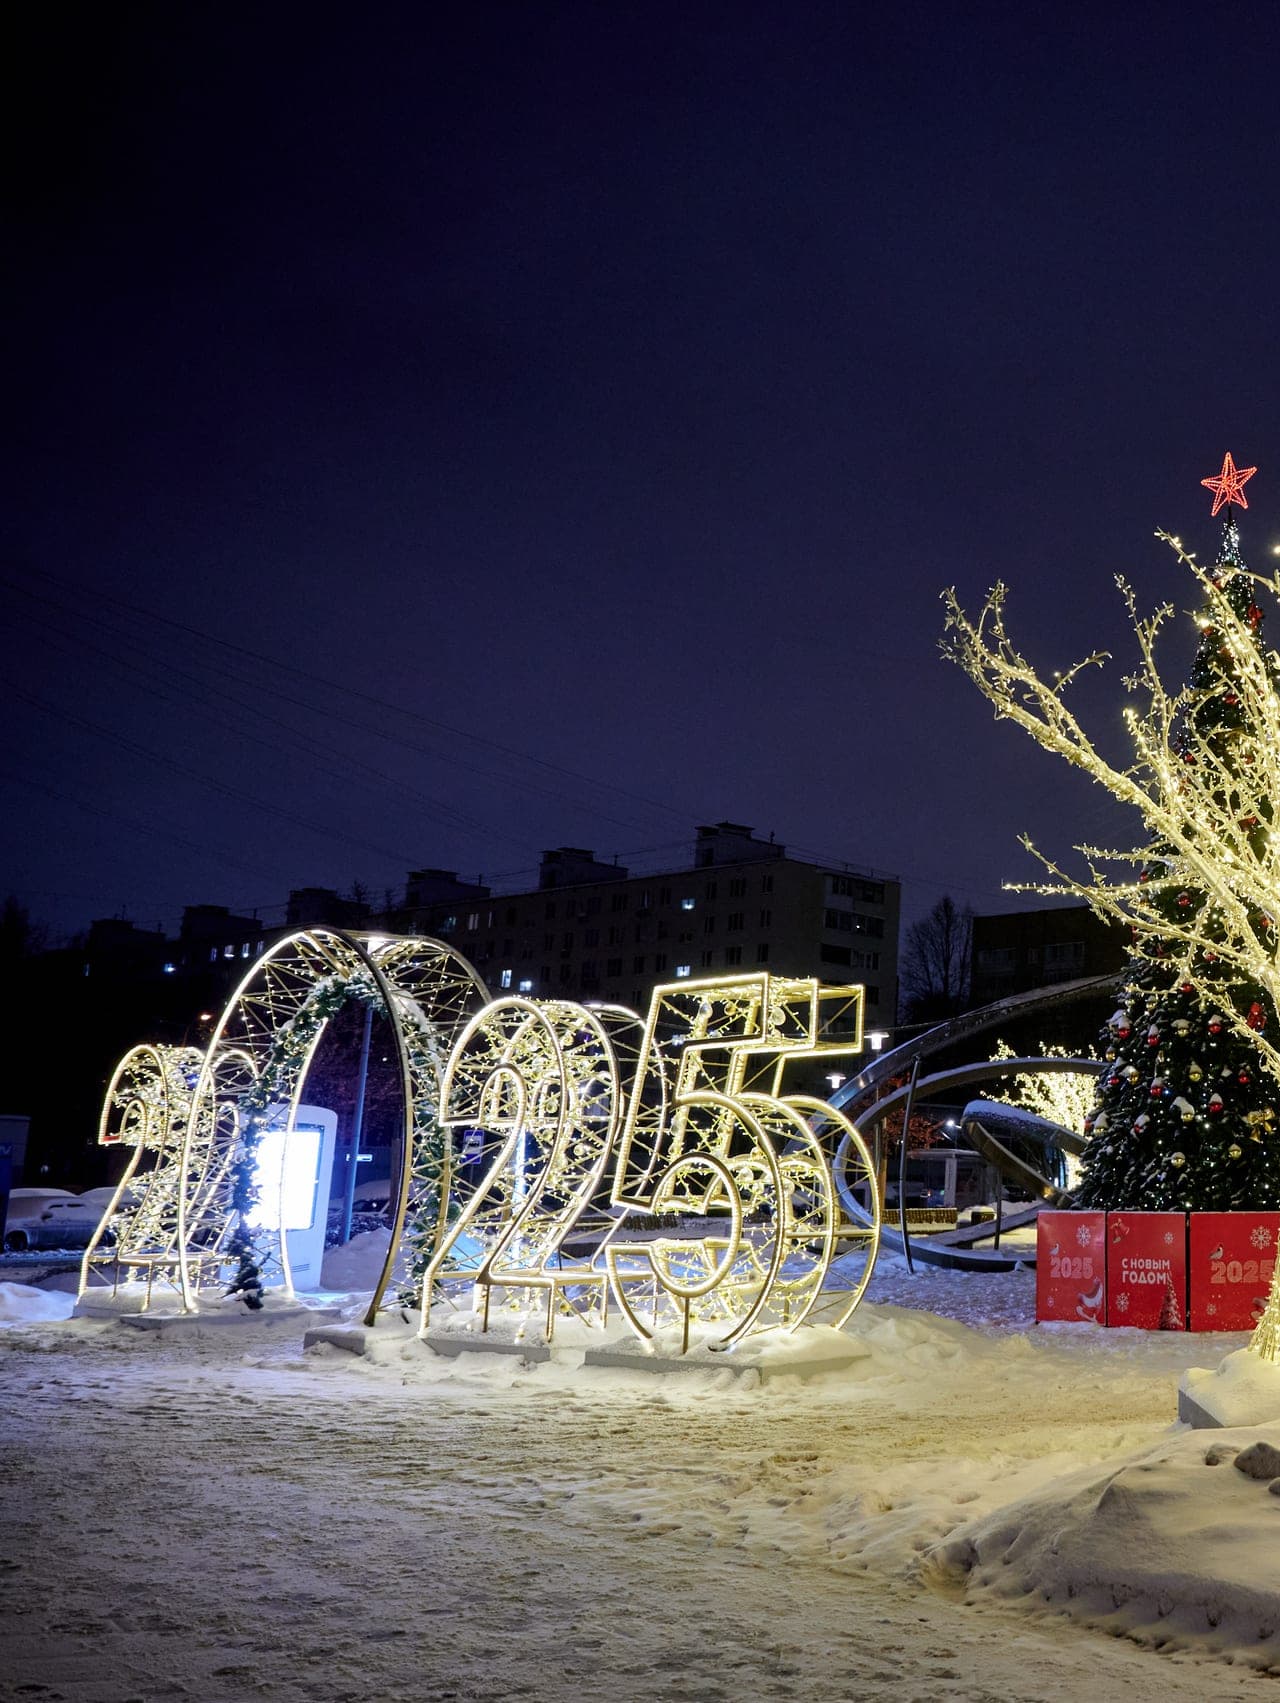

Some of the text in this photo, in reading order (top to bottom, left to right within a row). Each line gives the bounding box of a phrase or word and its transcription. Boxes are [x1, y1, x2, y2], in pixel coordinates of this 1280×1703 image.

[1050, 1256, 1094, 1280] 2025
[1121, 1257, 1171, 1271] С НОВЫМ
[1210, 1259, 1275, 1284] 2025
